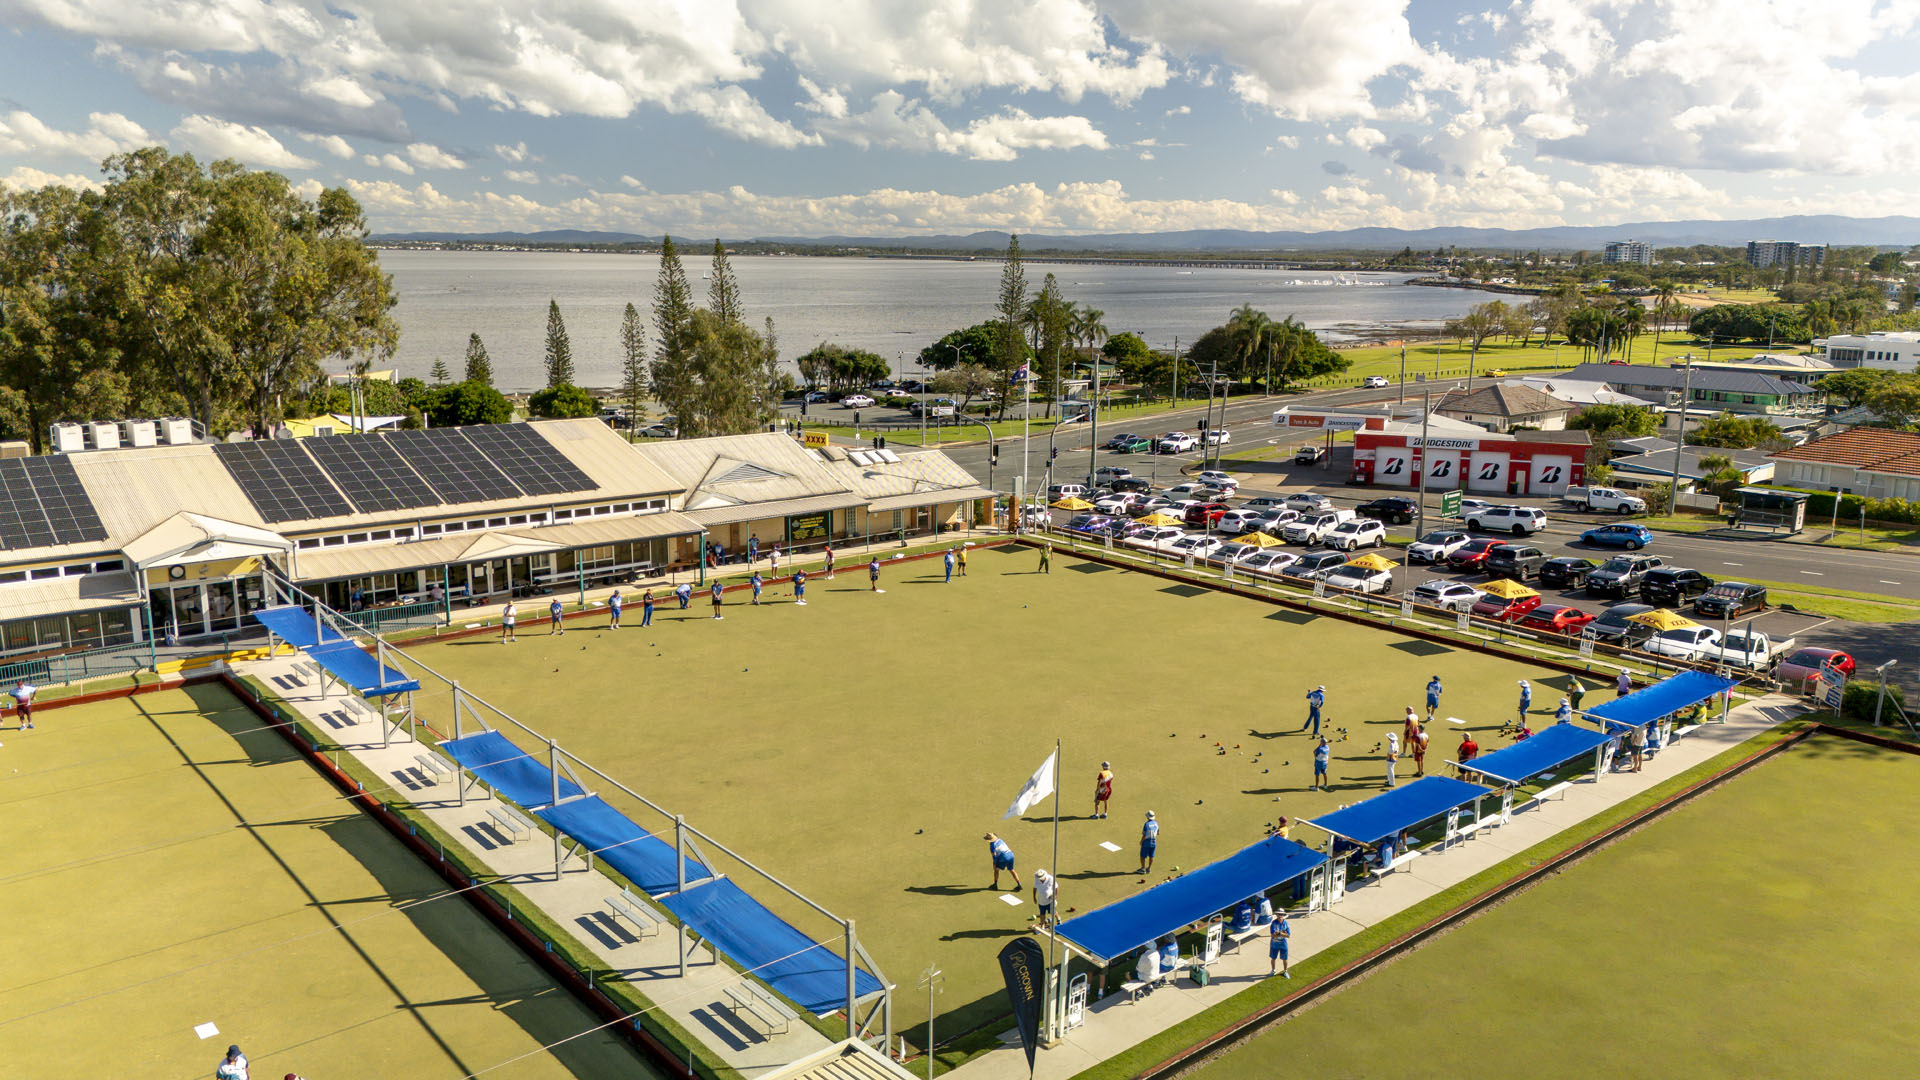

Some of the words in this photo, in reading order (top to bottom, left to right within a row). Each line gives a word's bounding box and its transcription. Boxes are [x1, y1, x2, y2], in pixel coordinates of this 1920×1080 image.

[806, 435, 826, 444] XXXX
[1484, 585, 1502, 593] XXXX
[1639, 615, 1658, 625] XXXX
[1019, 965, 1034, 1000] CROWN
